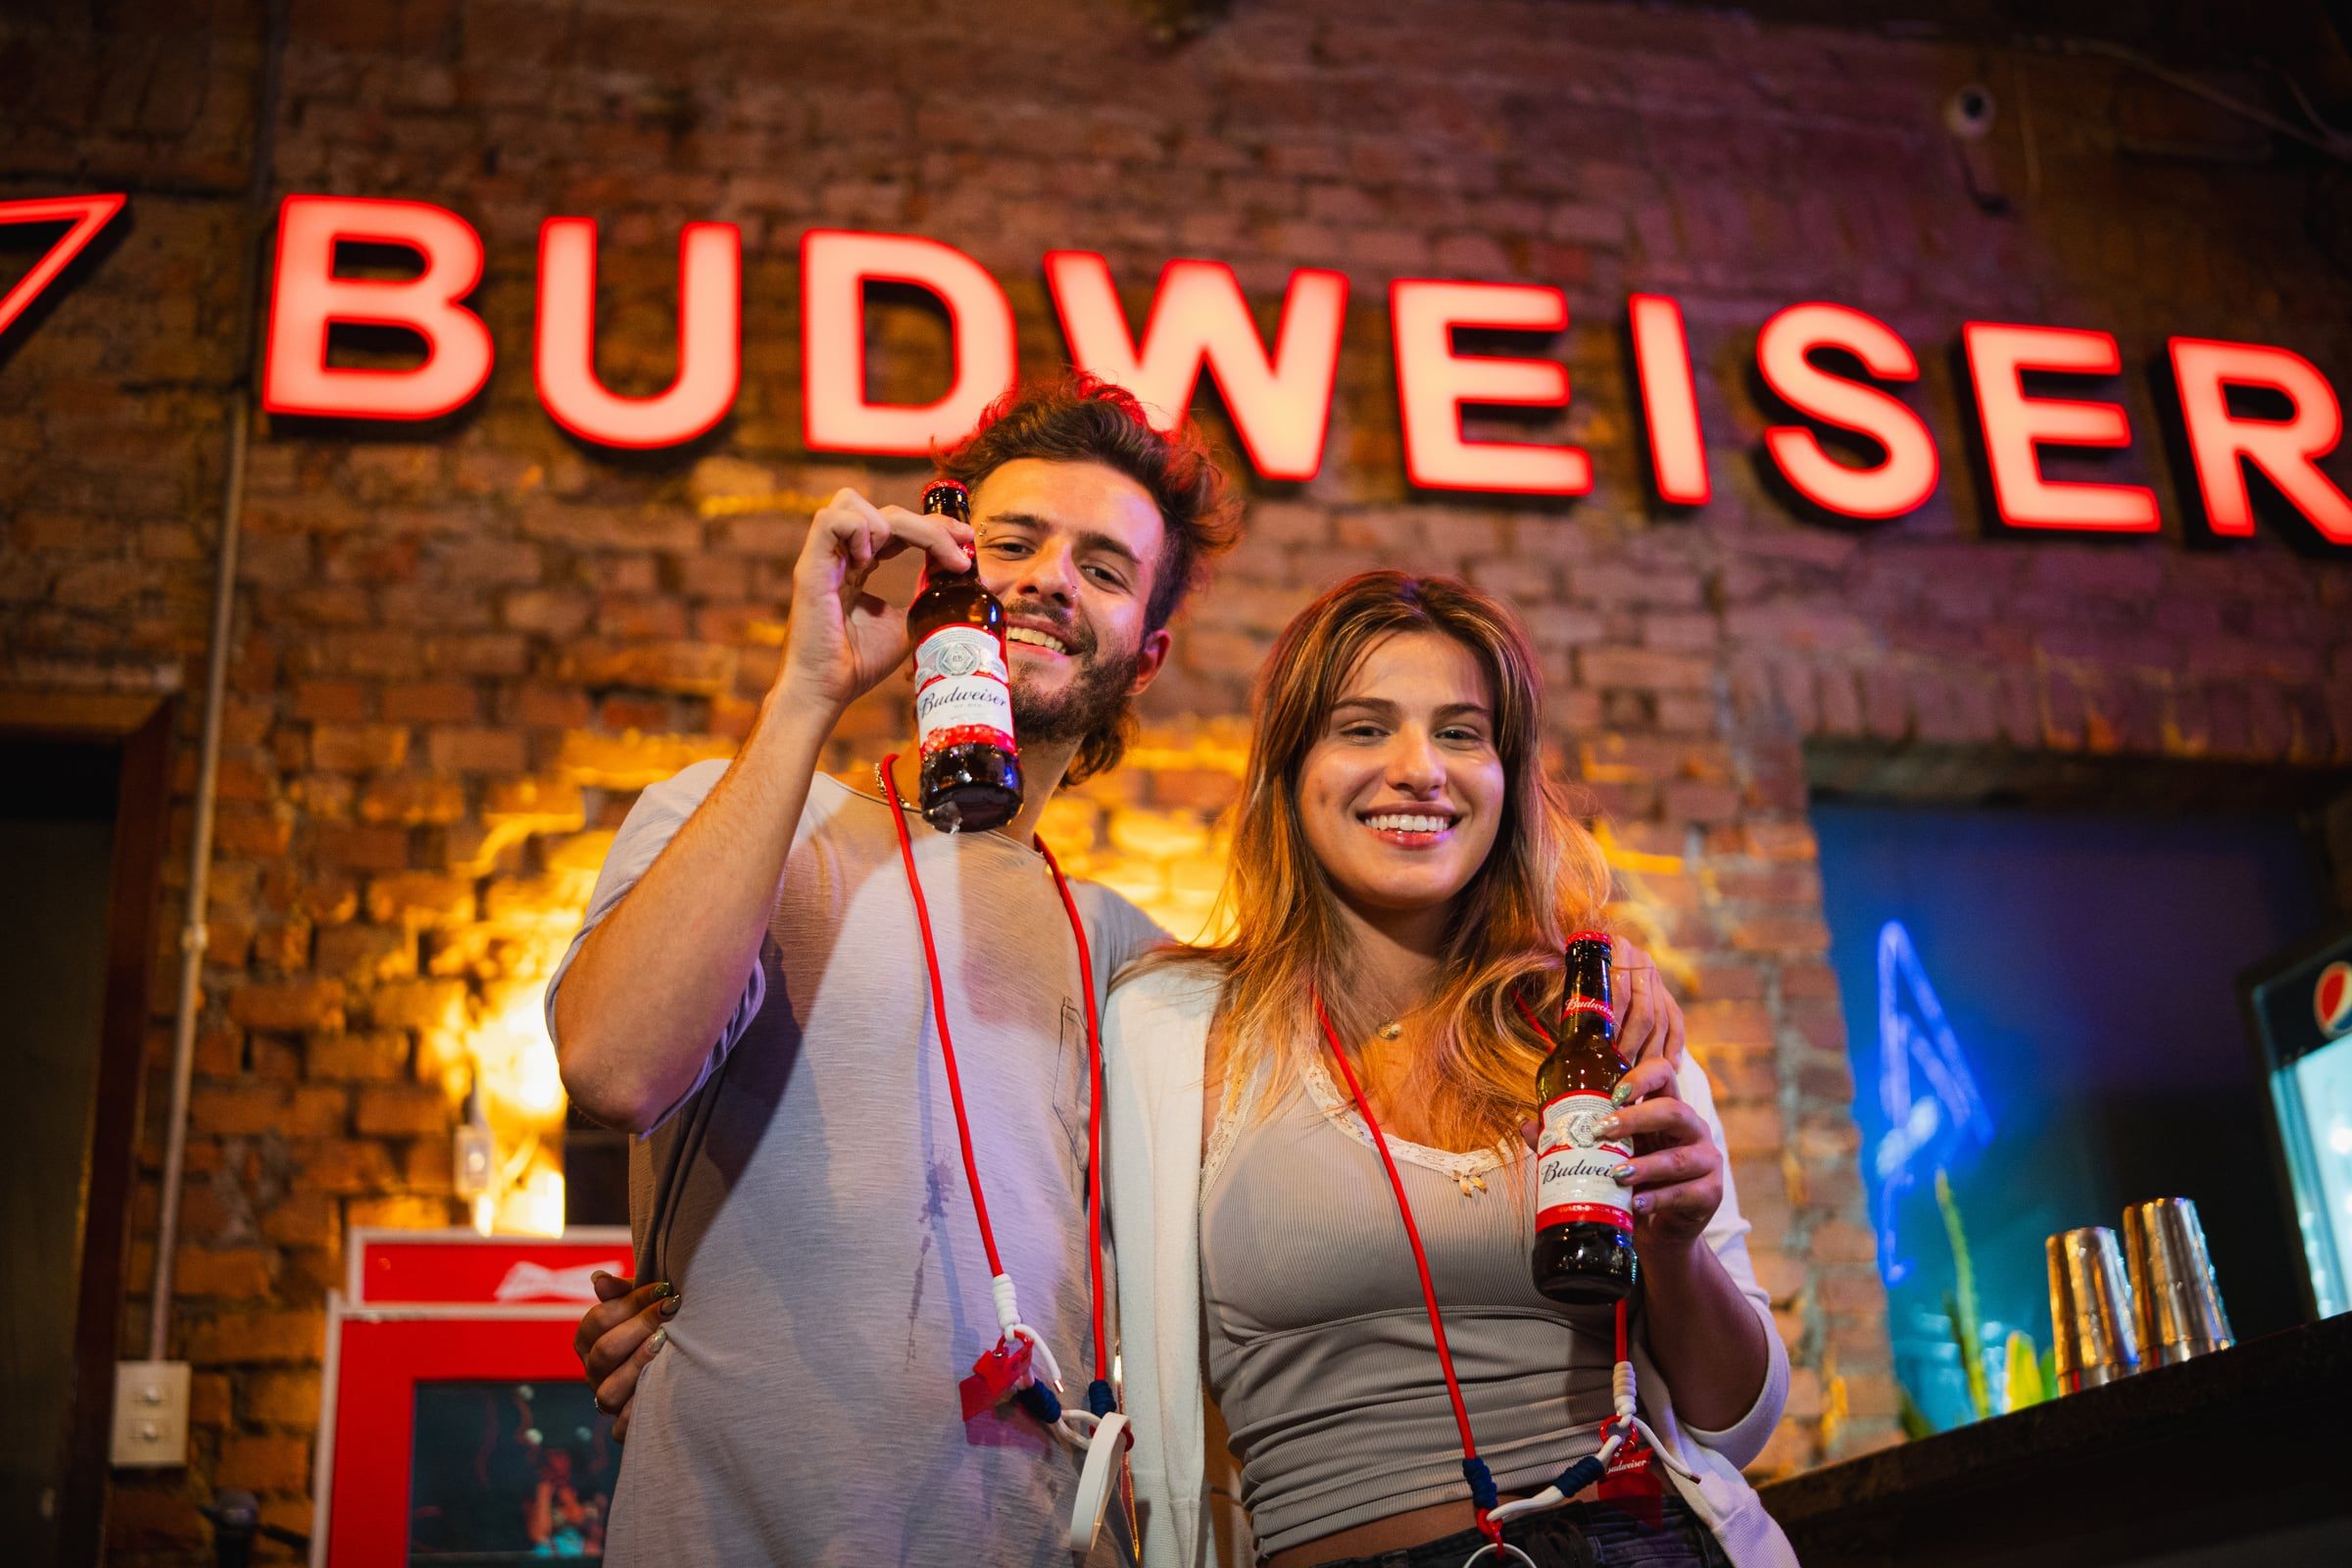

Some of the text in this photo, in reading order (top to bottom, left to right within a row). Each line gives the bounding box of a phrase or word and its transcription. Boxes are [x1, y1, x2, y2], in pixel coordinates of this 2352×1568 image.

[263, 192, 2352, 546] BUDWEISER
[919, 686, 1006, 719] Budweiser
[1542, 1158, 1614, 1184] Budwei
